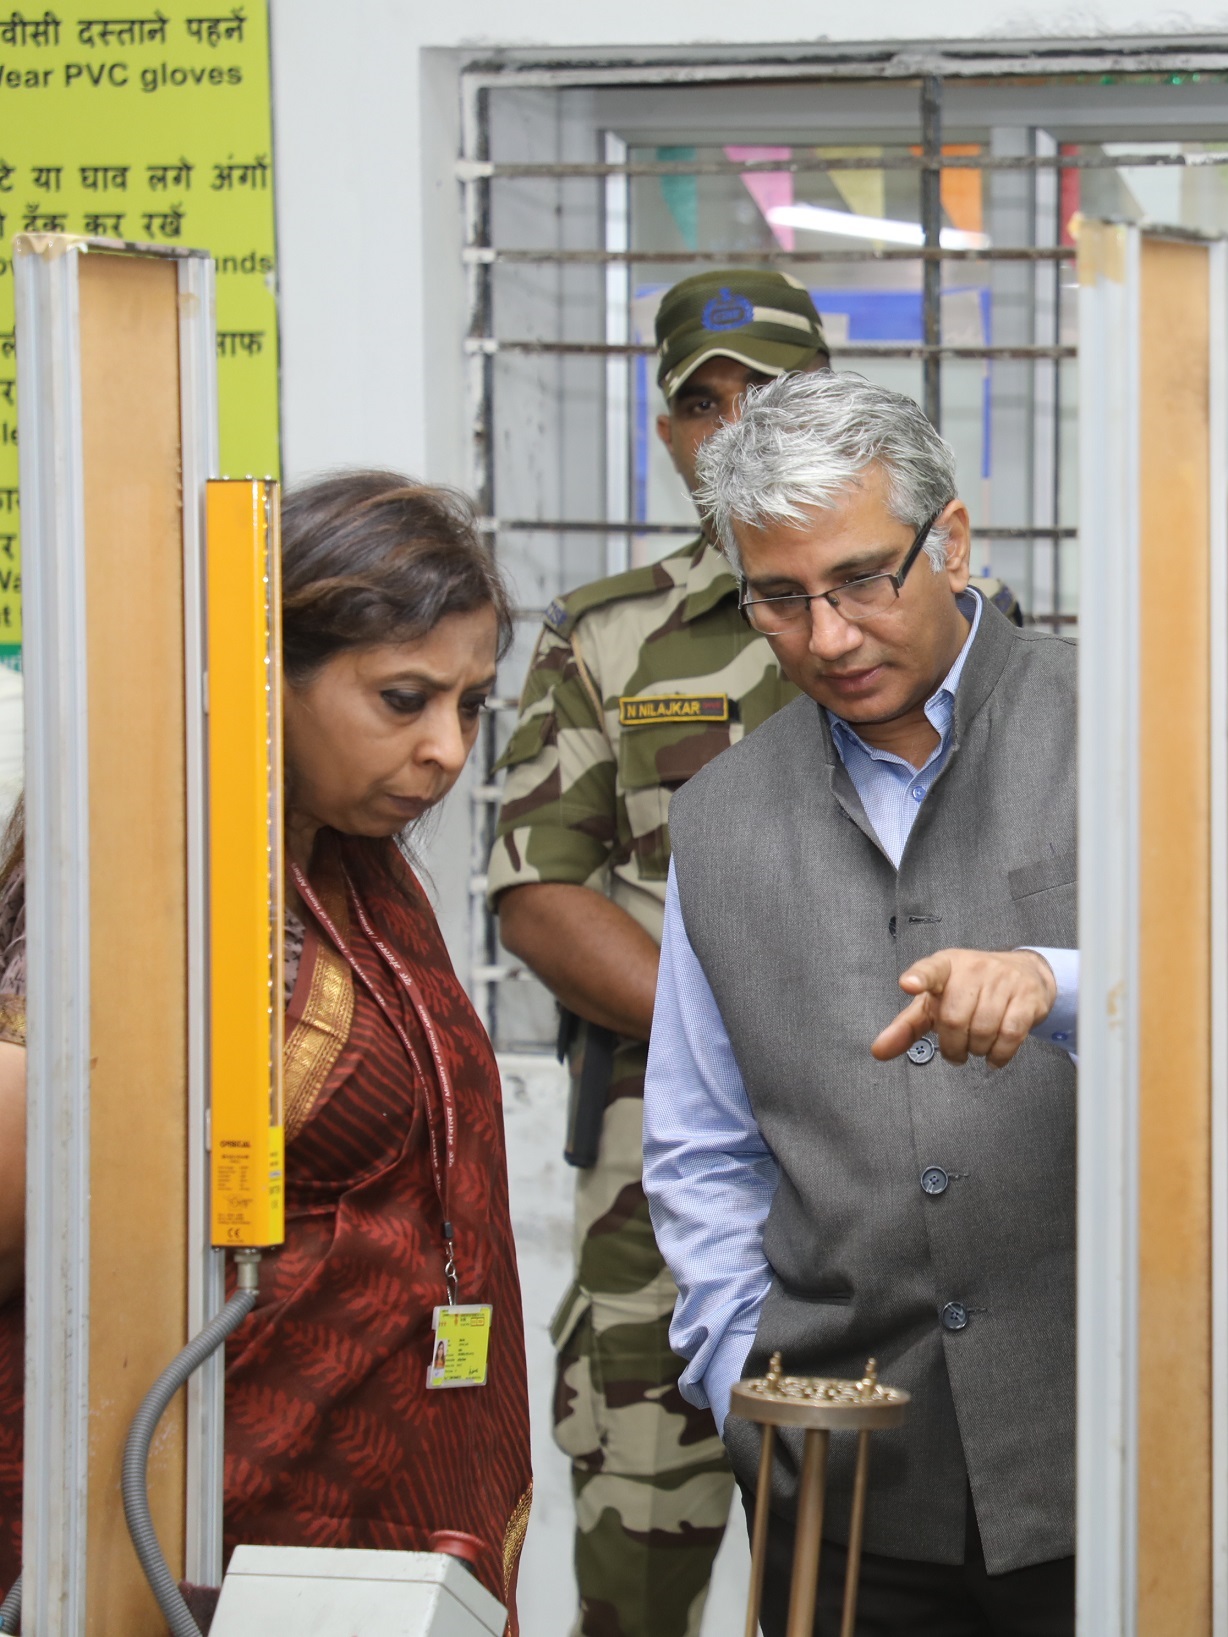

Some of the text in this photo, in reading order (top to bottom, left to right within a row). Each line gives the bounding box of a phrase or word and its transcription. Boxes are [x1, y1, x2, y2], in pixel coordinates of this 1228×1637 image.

[77, 10, 169, 48] दस्ताने
[186, 6, 247, 48] पहनें
[0, 62, 243, 92] ear PVC gloves
[31, 167, 64, 192] या
[79, 166, 130, 192] घाव
[147, 156, 194, 191] लगे
[84, 213, 127, 238] कर
[638, 701, 701, 717] NILAJKAR
